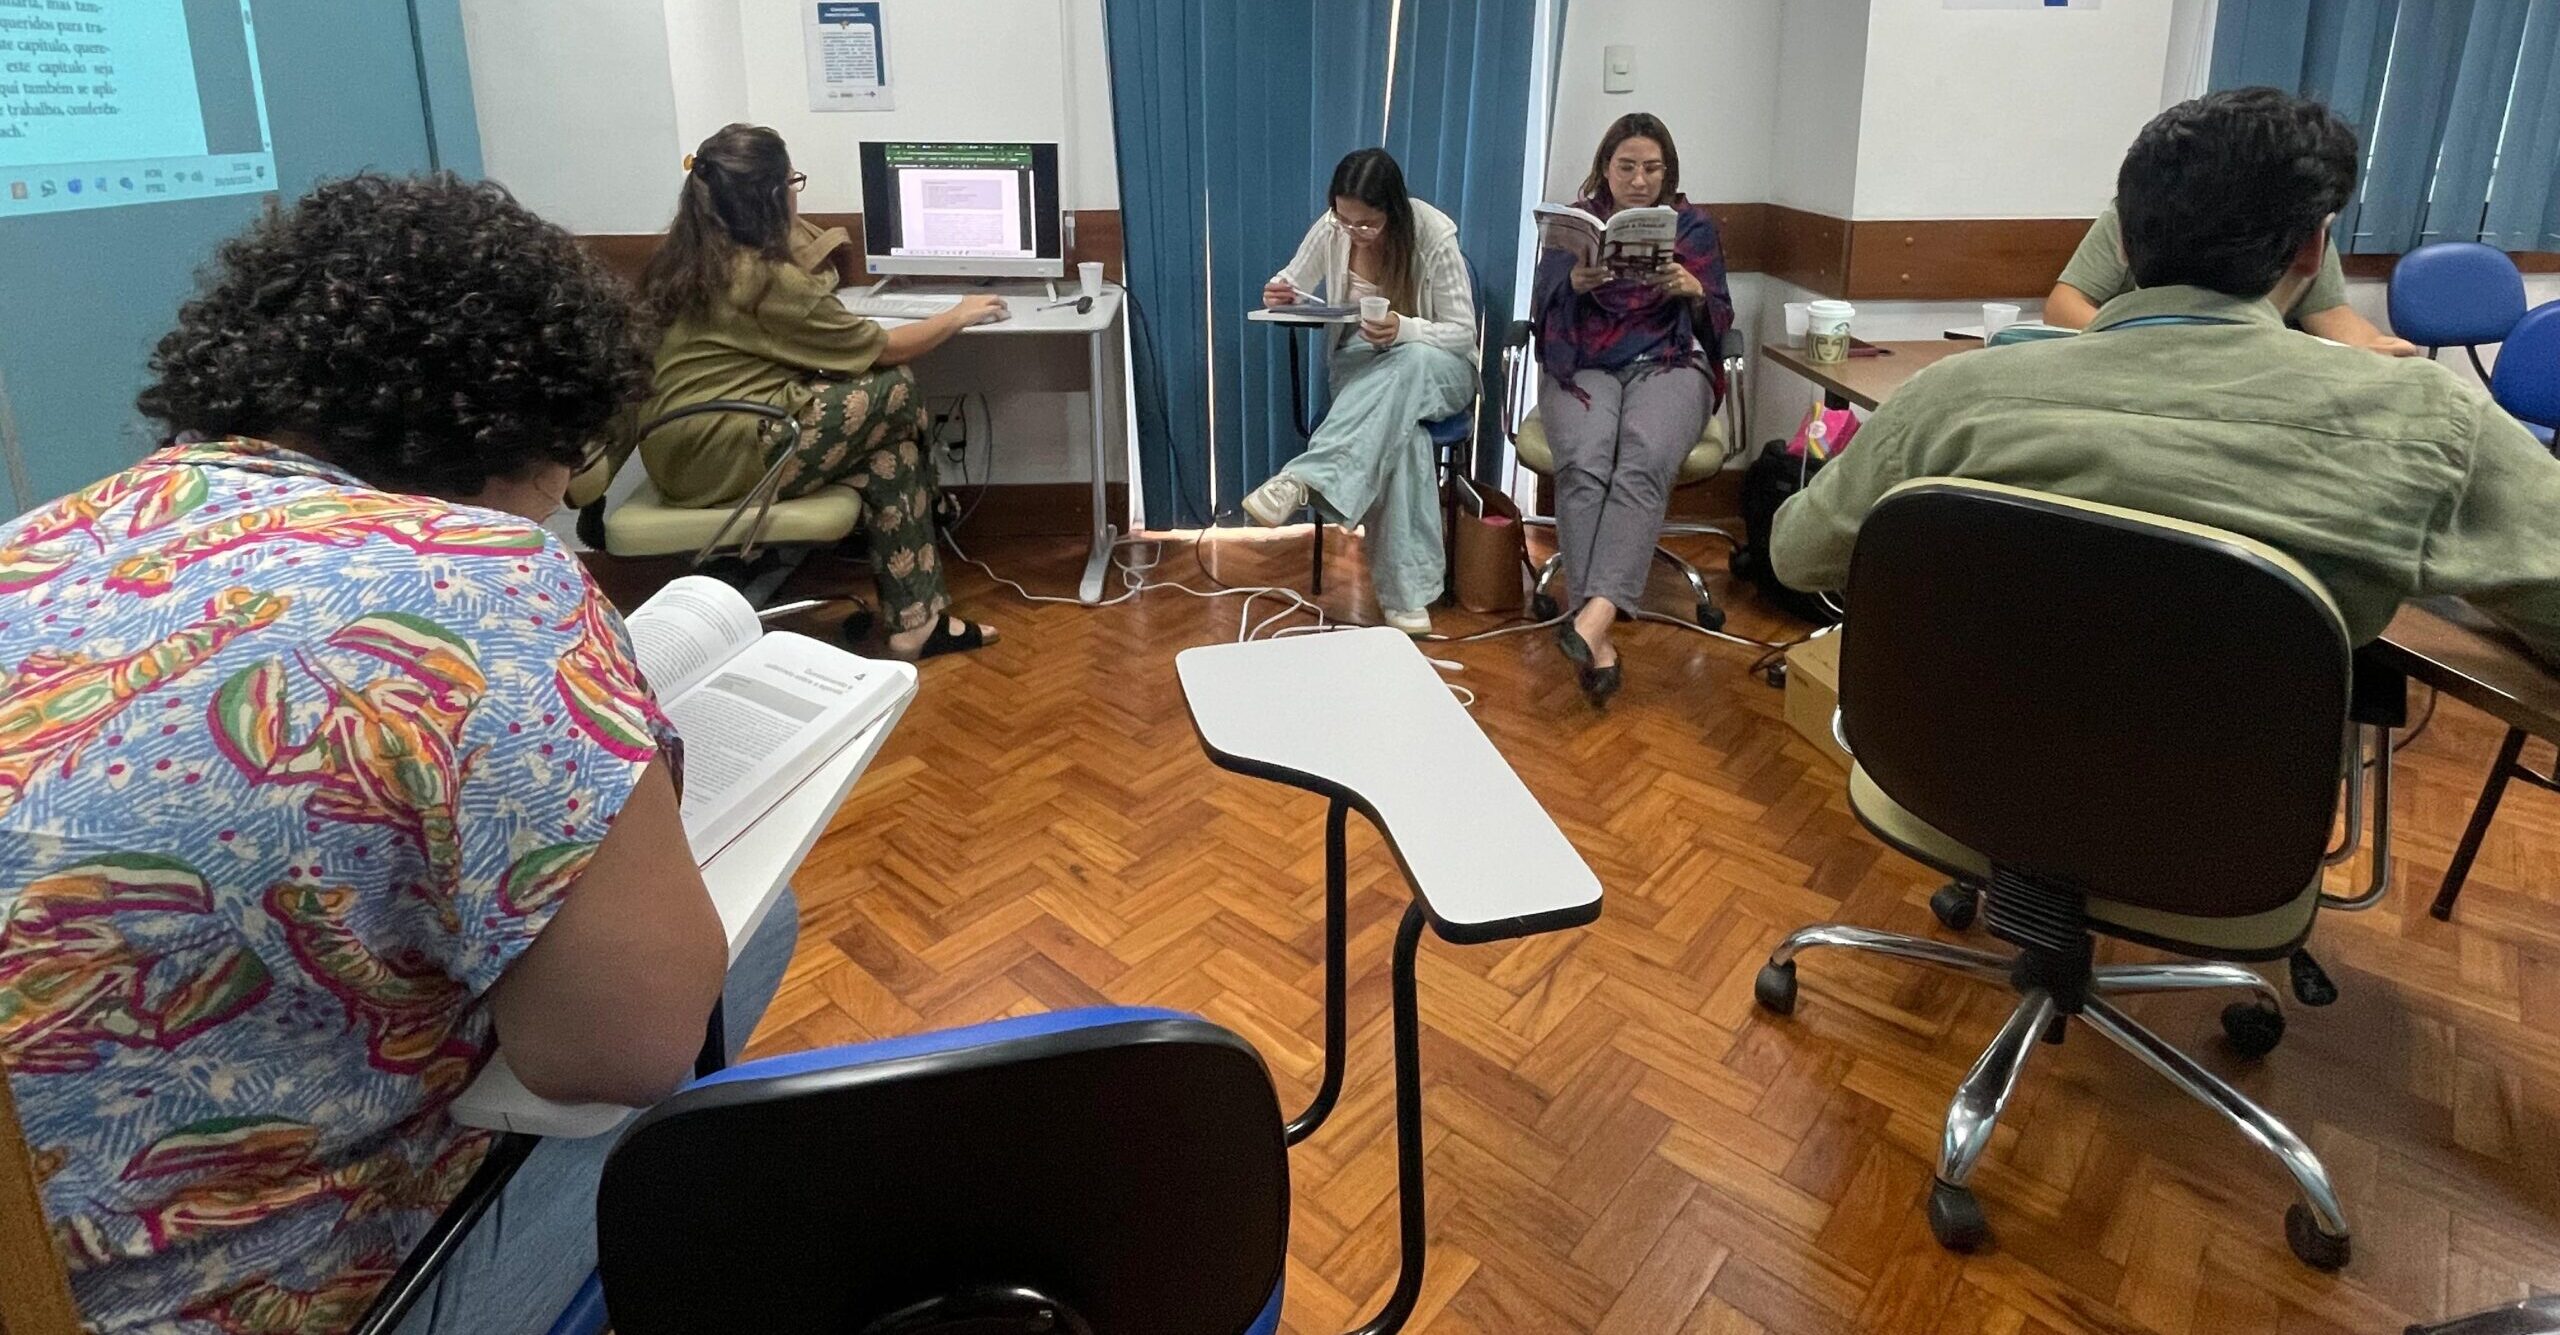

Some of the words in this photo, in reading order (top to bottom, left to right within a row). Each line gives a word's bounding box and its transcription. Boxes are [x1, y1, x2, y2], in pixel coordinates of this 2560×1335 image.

[0, 16, 54, 32] queridos
[57, 22, 83, 36] para
[6, 62, 31, 73] este
[93, 64, 114, 78] seja
[77, 85, 89, 94] se
[7, 99, 65, 116] trabalho,
